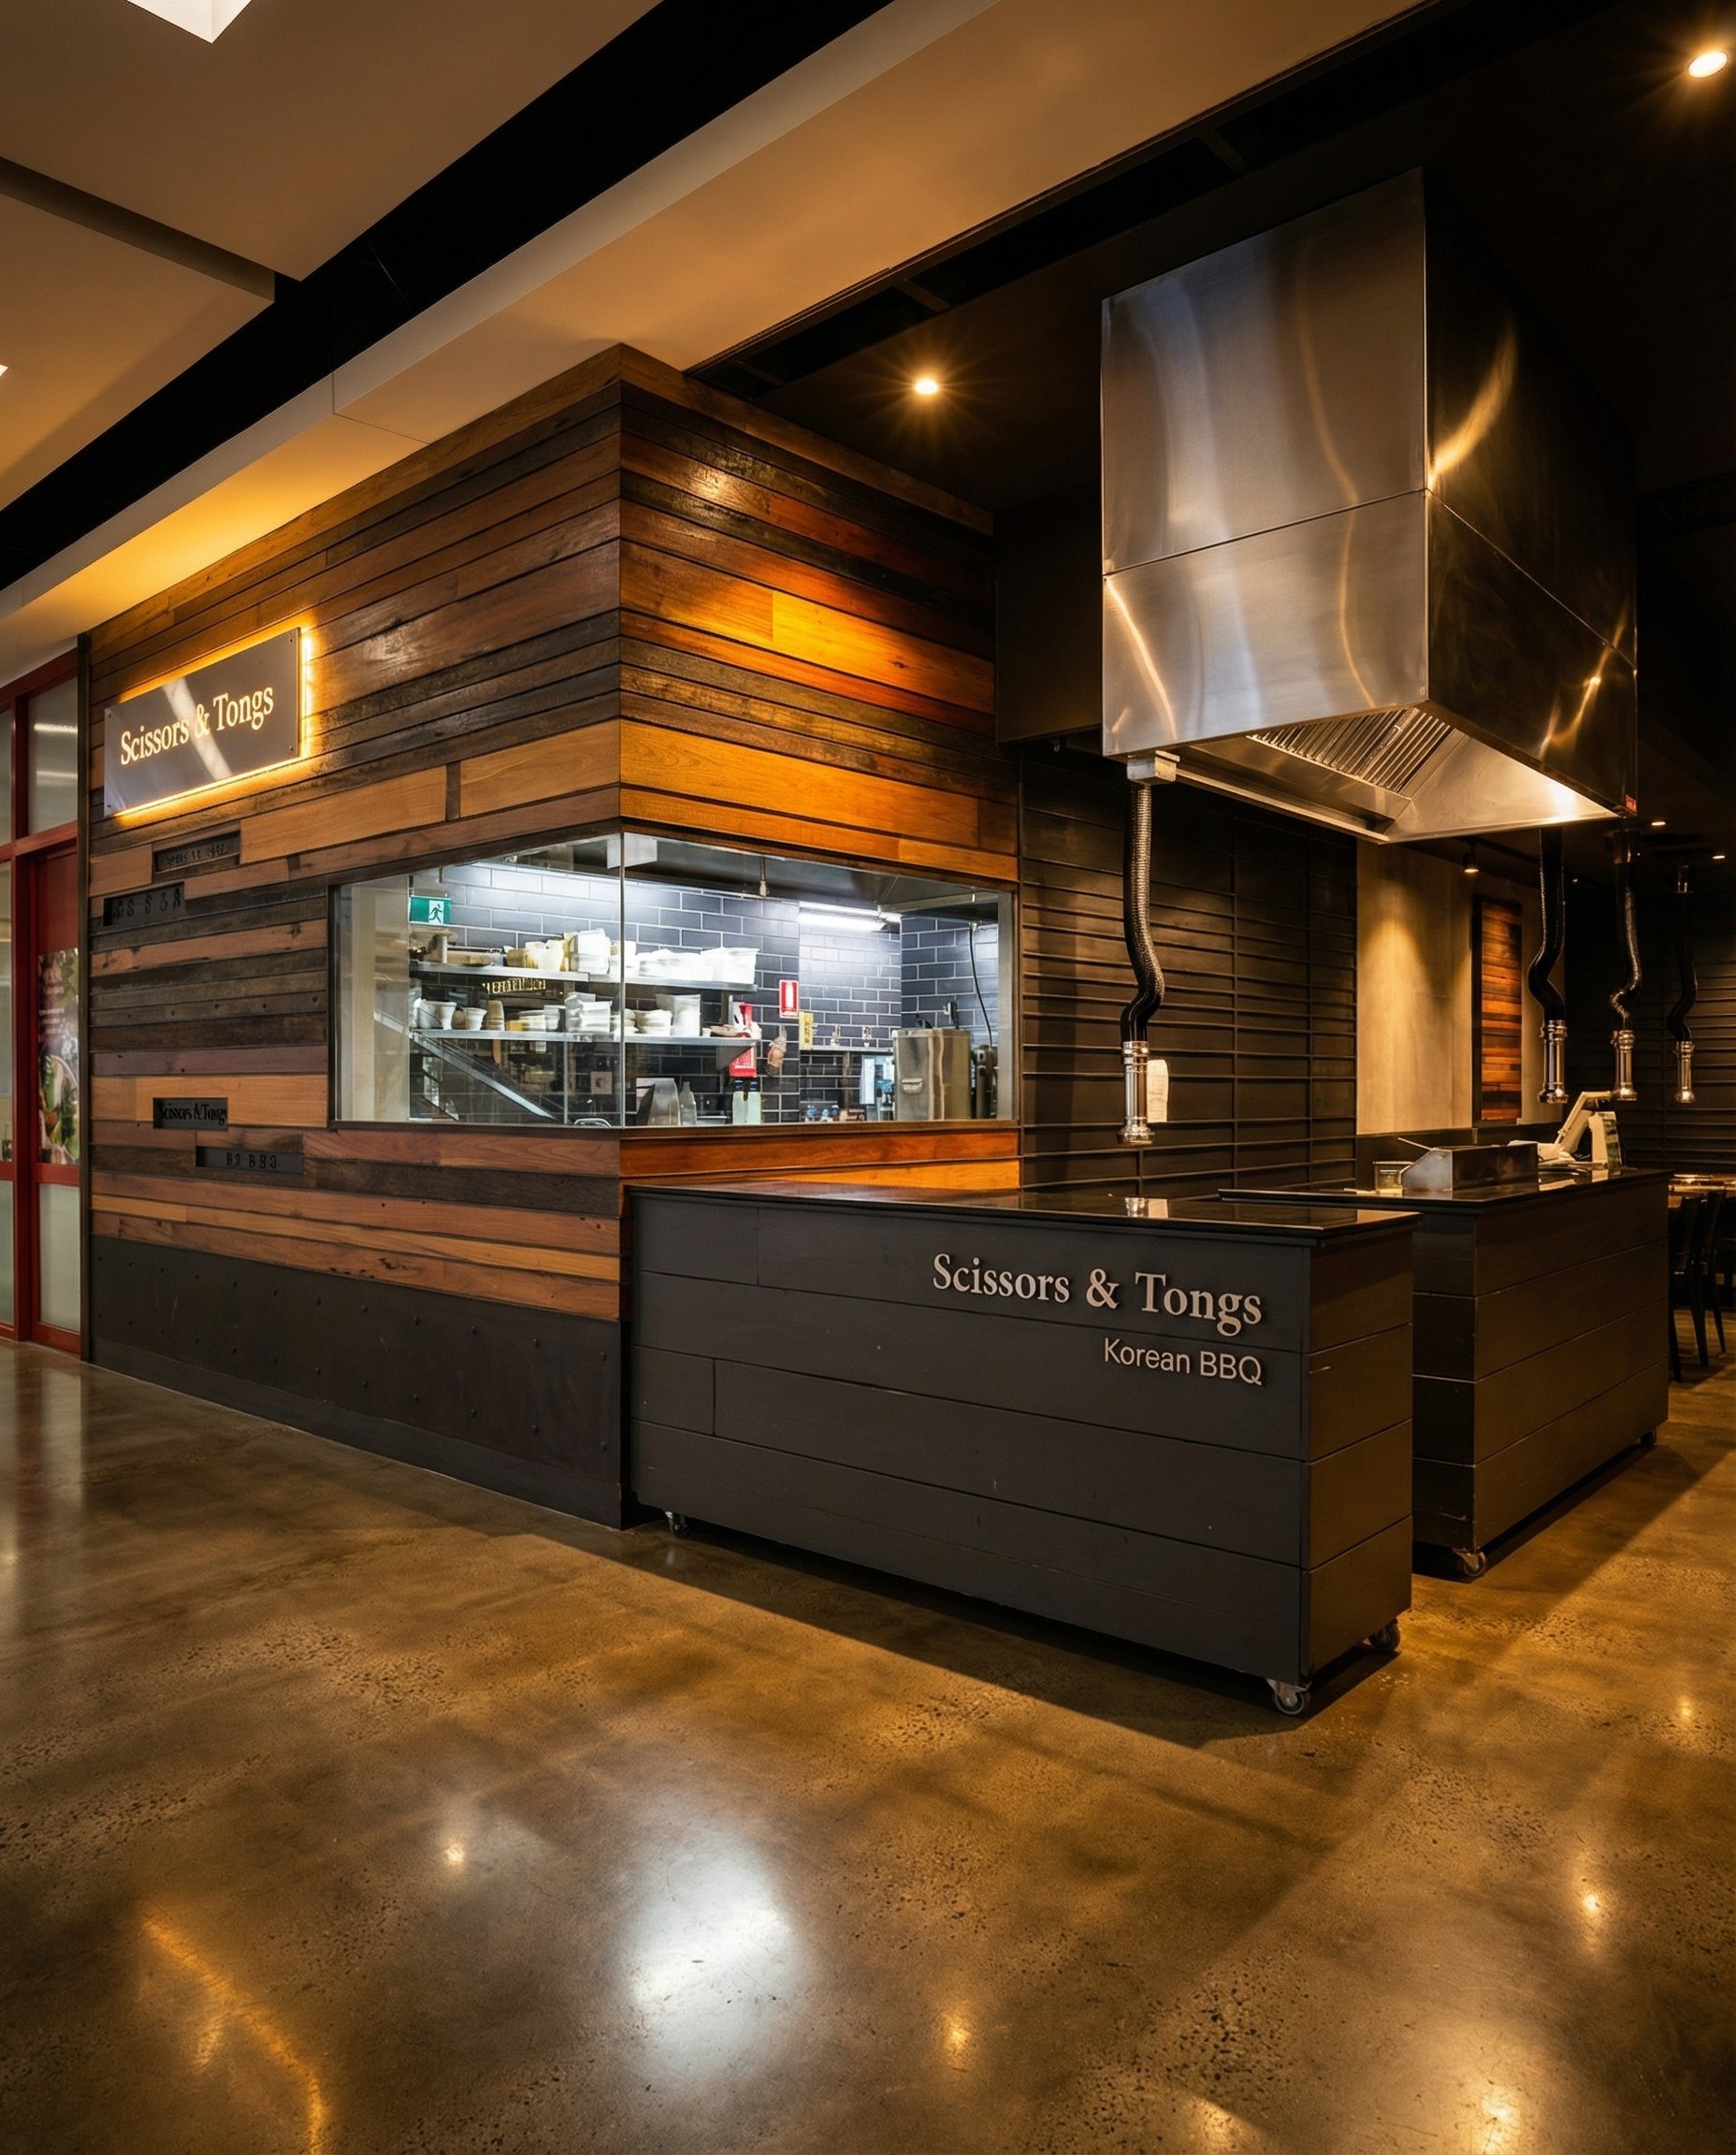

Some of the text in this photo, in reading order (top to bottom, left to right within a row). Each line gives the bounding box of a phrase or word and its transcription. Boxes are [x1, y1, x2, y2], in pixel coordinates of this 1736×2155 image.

[121, 687, 274, 765] Scissors & Tongs
[933, 1252, 1263, 1337] Scissors & Tongs
[1104, 1338, 1263, 1386] Korean BBQ
